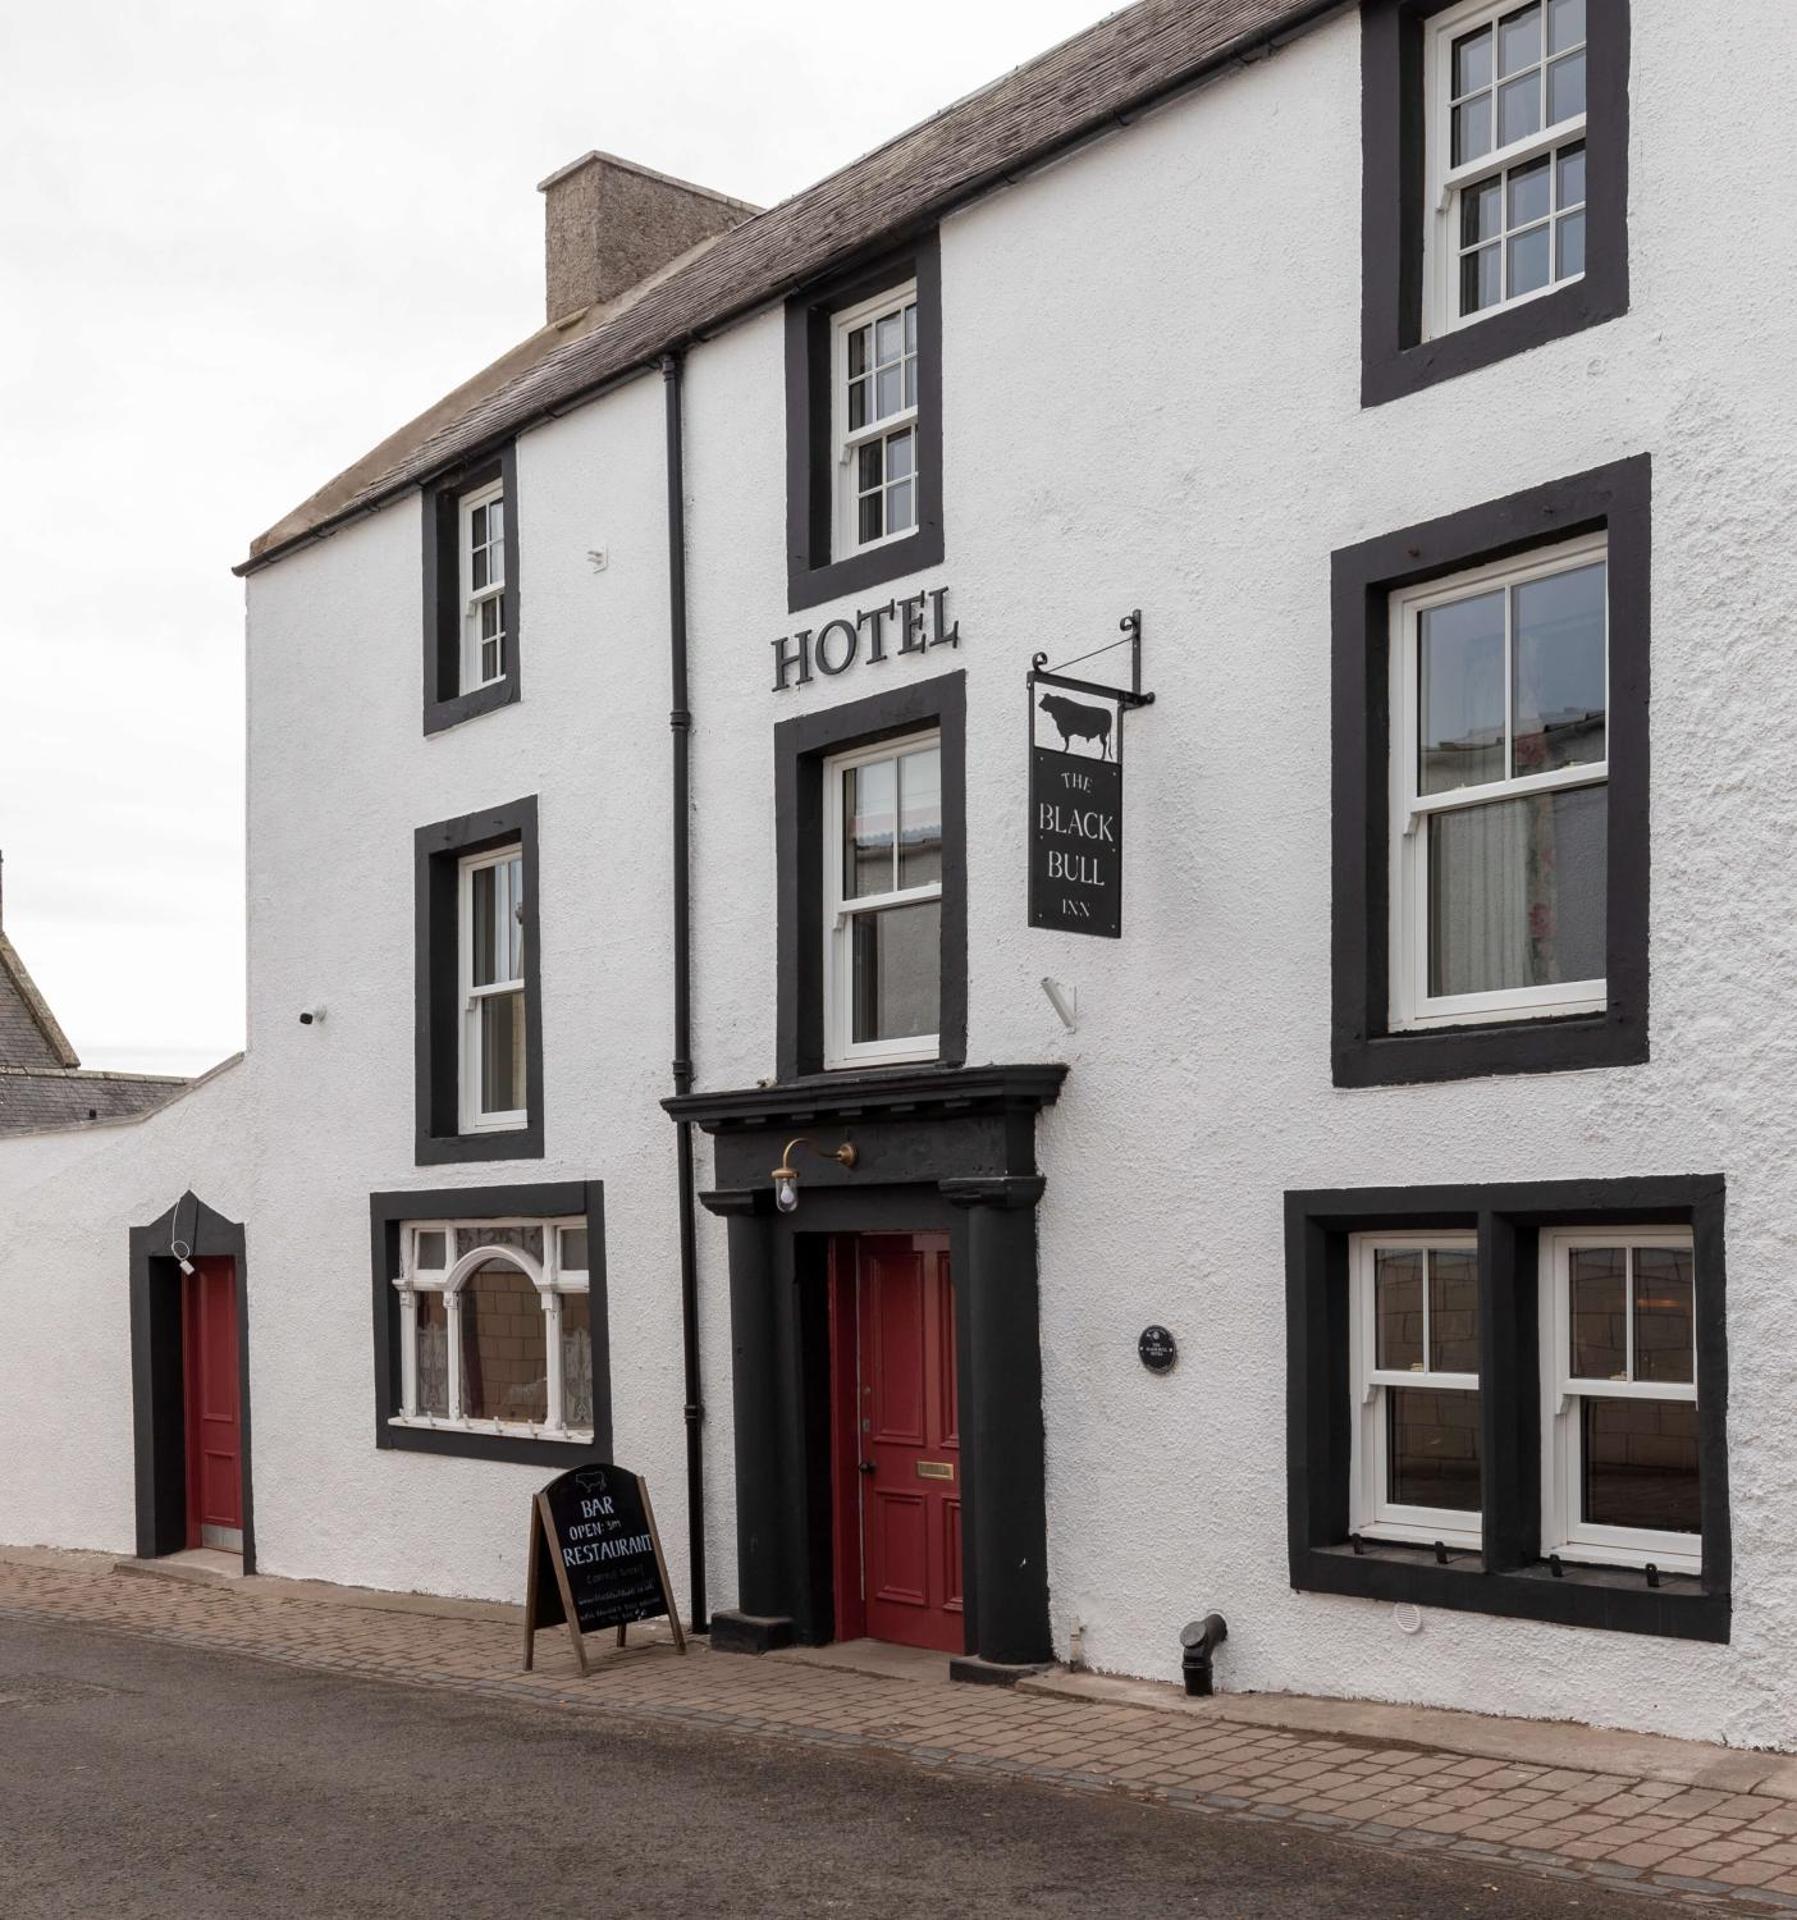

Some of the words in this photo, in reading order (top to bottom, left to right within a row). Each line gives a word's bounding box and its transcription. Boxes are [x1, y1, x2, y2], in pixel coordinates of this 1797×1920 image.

[770, 586, 960, 693] HOTEL
[1060, 772, 1093, 794] THE
[1039, 802, 1113, 843] BLACK
[1048, 850, 1105, 887] BULL
[1062, 898, 1091, 918] INN
[581, 1496, 614, 1518] BAR
[563, 1534, 652, 1567] RESTAURANT
